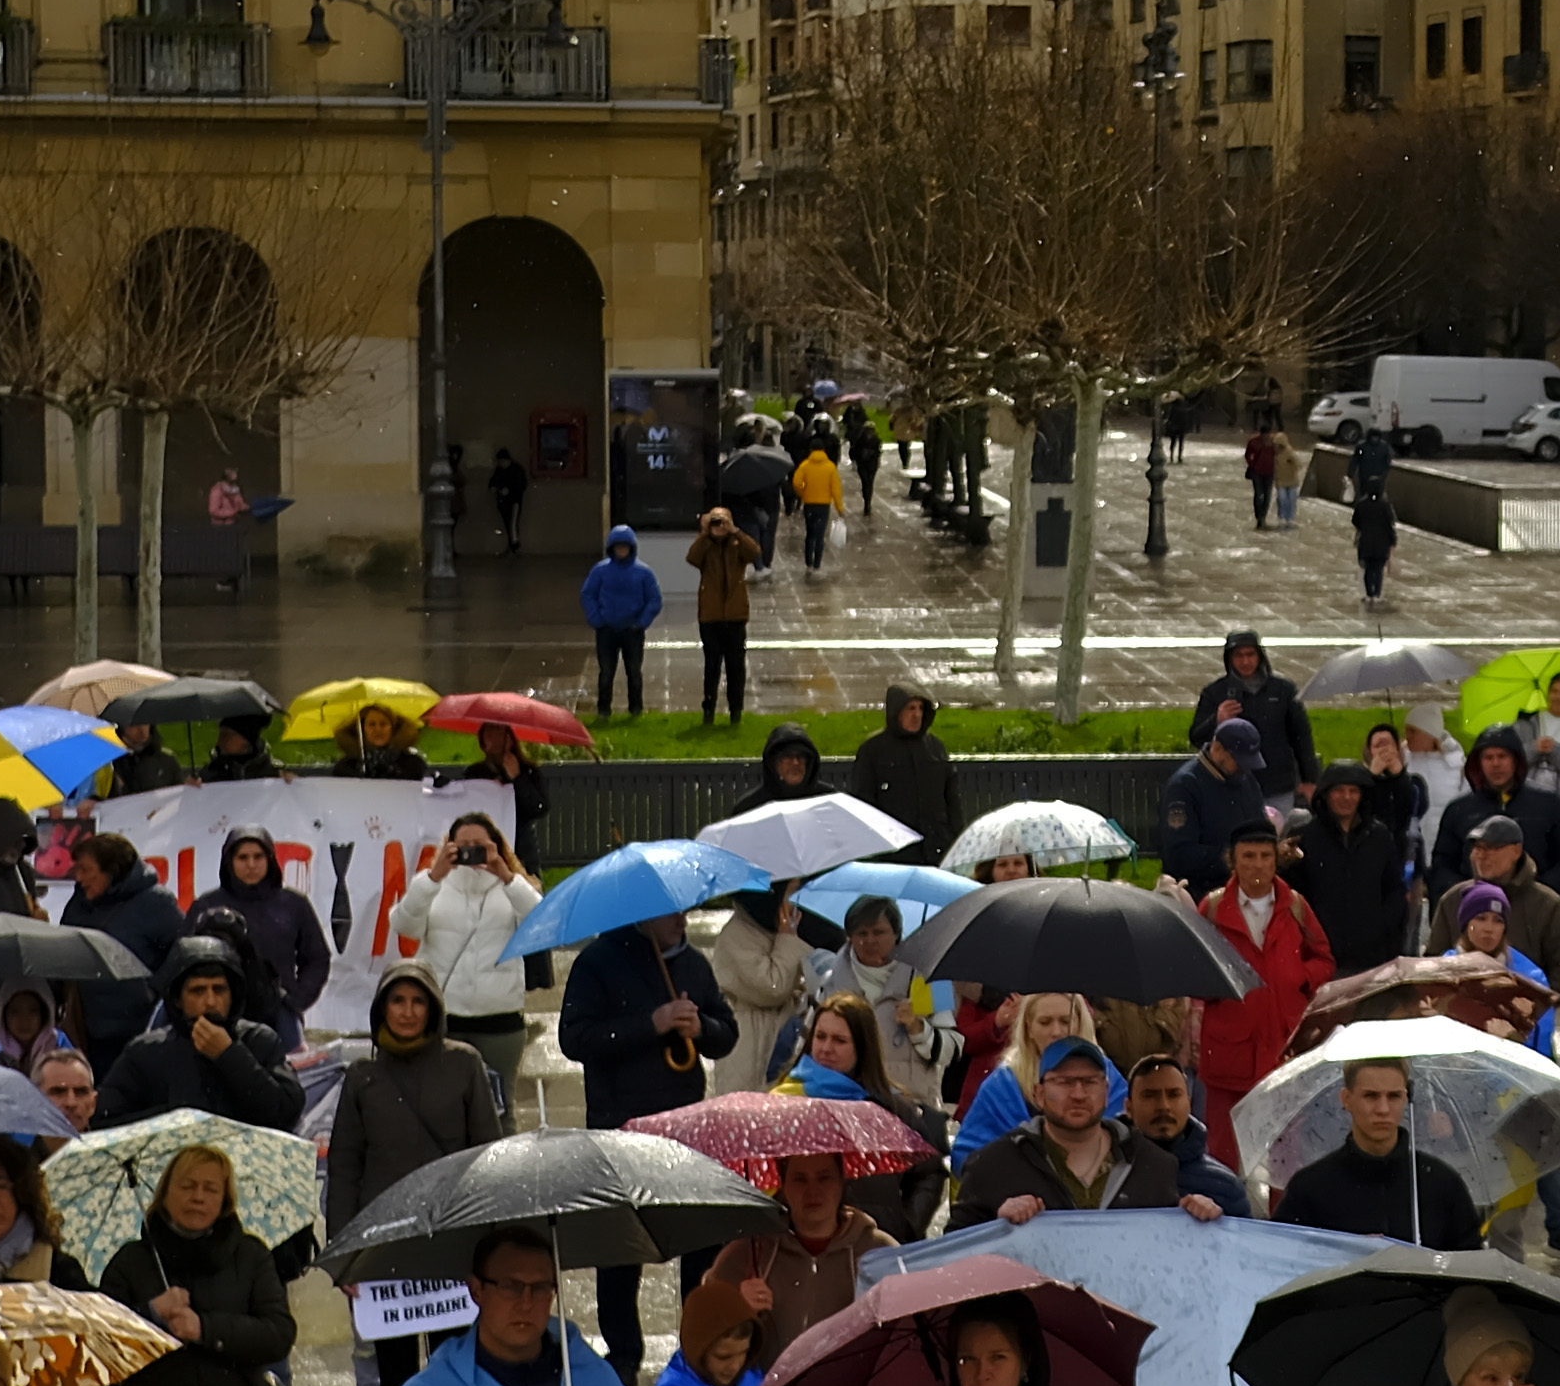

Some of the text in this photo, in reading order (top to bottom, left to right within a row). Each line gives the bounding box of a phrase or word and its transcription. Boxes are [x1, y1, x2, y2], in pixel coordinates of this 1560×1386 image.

[370, 1279, 467, 1302] THE GENOCI
[384, 1295, 470, 1324] IN UKRAINE
